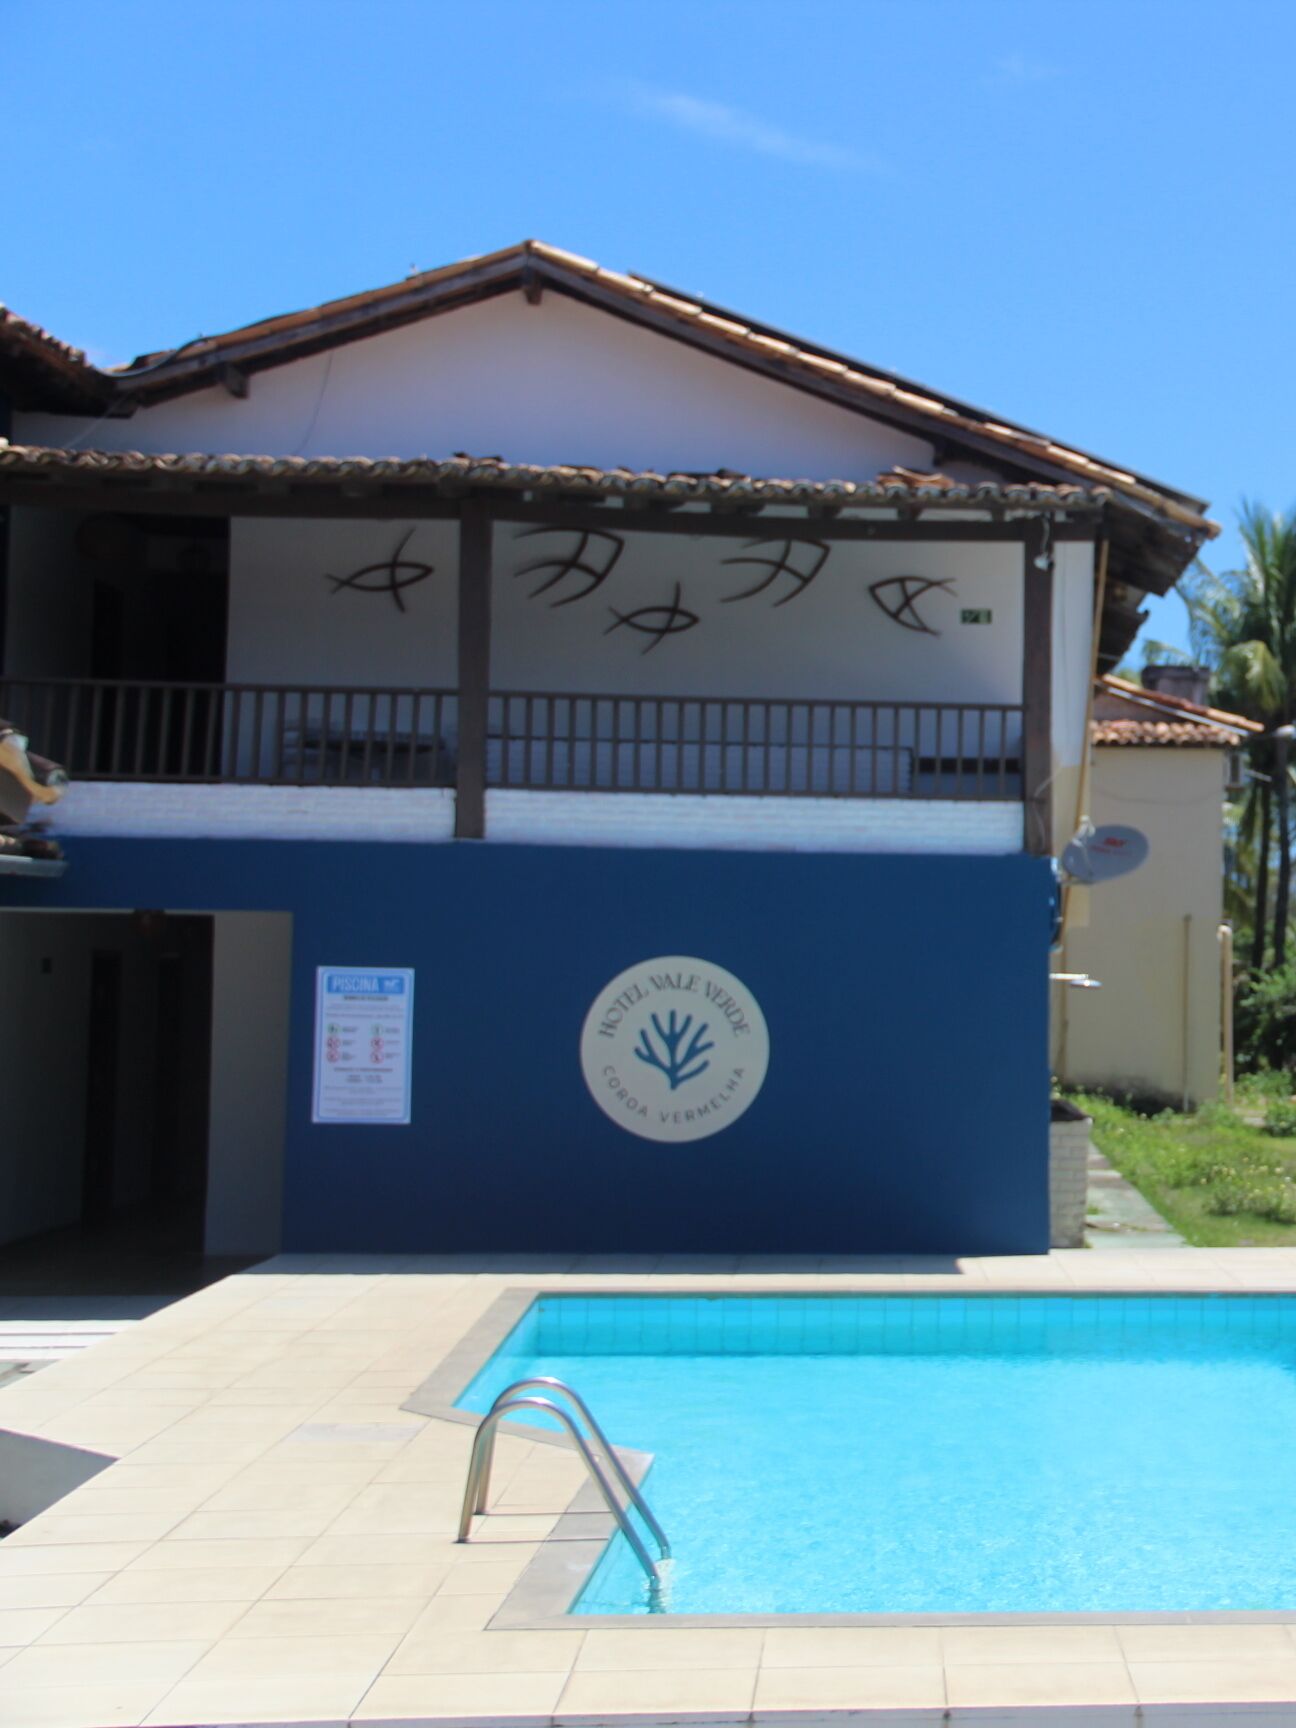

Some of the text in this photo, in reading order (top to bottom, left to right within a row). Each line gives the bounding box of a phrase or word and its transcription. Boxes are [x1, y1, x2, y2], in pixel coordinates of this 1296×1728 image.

[332, 976, 379, 992] PISCINA
[598, 972, 751, 1038] HOTEL VALE VERDE
[603, 1065, 745, 1124] COROA VERMELHA
